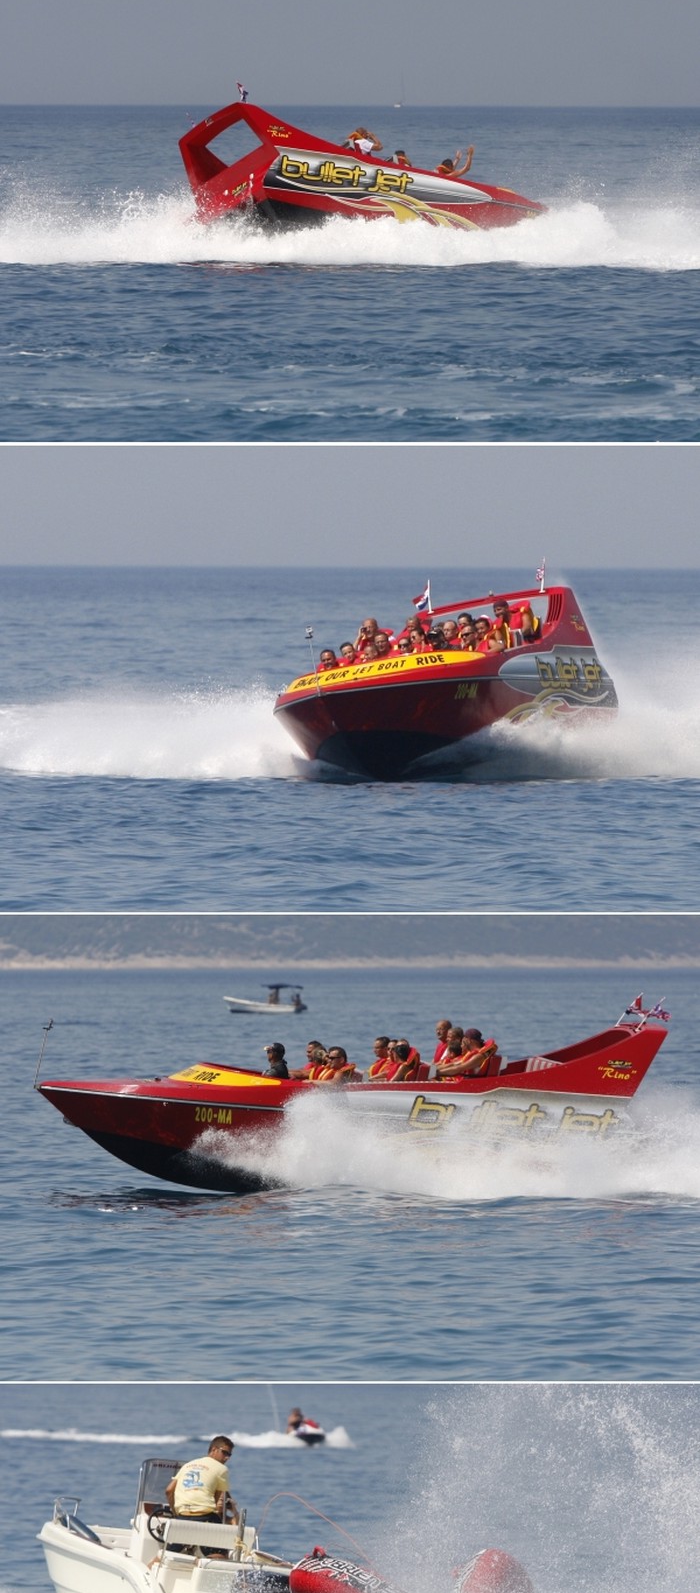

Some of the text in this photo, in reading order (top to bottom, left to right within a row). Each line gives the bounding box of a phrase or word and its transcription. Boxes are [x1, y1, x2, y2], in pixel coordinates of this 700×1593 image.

[281, 154, 414, 194] bullet jet
[325, 670, 349, 682] OUR
[353, 665, 374, 676] JET
[377, 659, 407, 671] BOAT
[416, 654, 445, 666] RIDE
[194, 1106, 233, 1125] 200-MA
